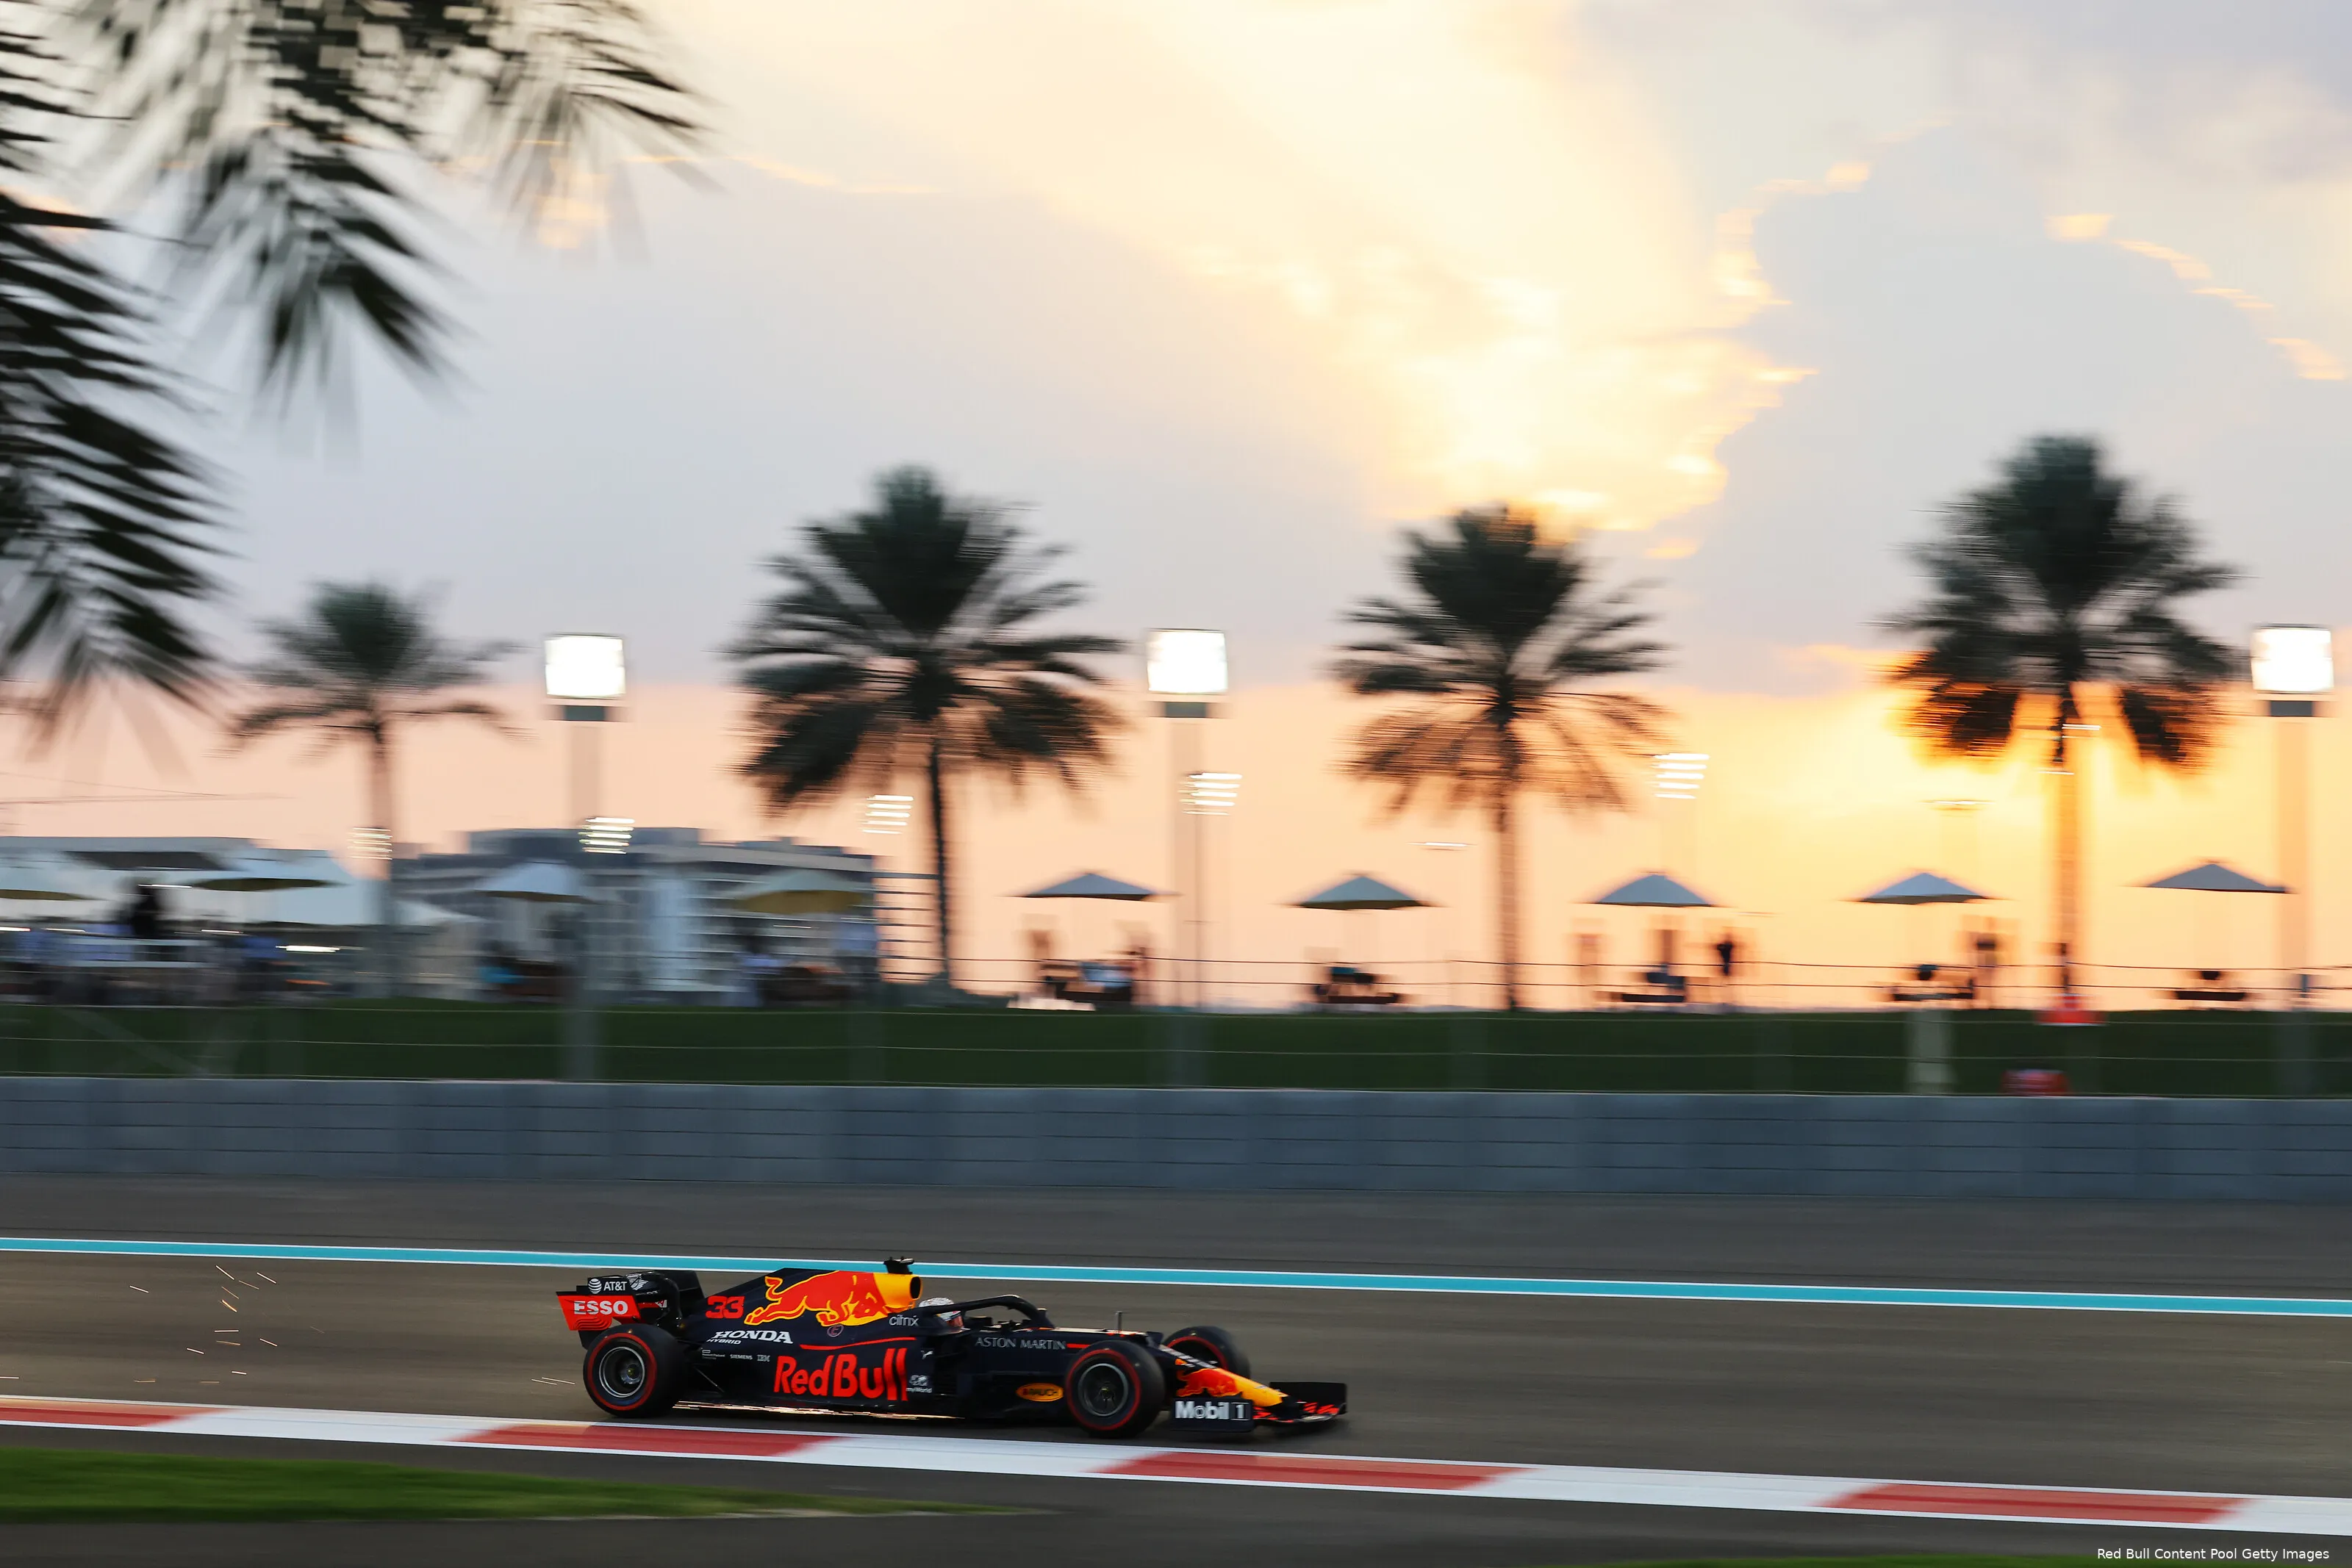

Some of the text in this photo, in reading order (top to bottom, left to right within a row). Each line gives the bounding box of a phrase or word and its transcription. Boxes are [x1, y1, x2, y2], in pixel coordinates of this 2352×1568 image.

[603, 1281, 627, 1291] AT&T
[573, 1300, 628, 1315] ESSO
[706, 1295, 745, 1319] 33
[711, 1330, 794, 1344] HONDA
[975, 1337, 1066, 1349] ASTON MARTIN
[1175, 1400, 1230, 1419] Mobil
[1236, 1404, 1244, 1419] 1
